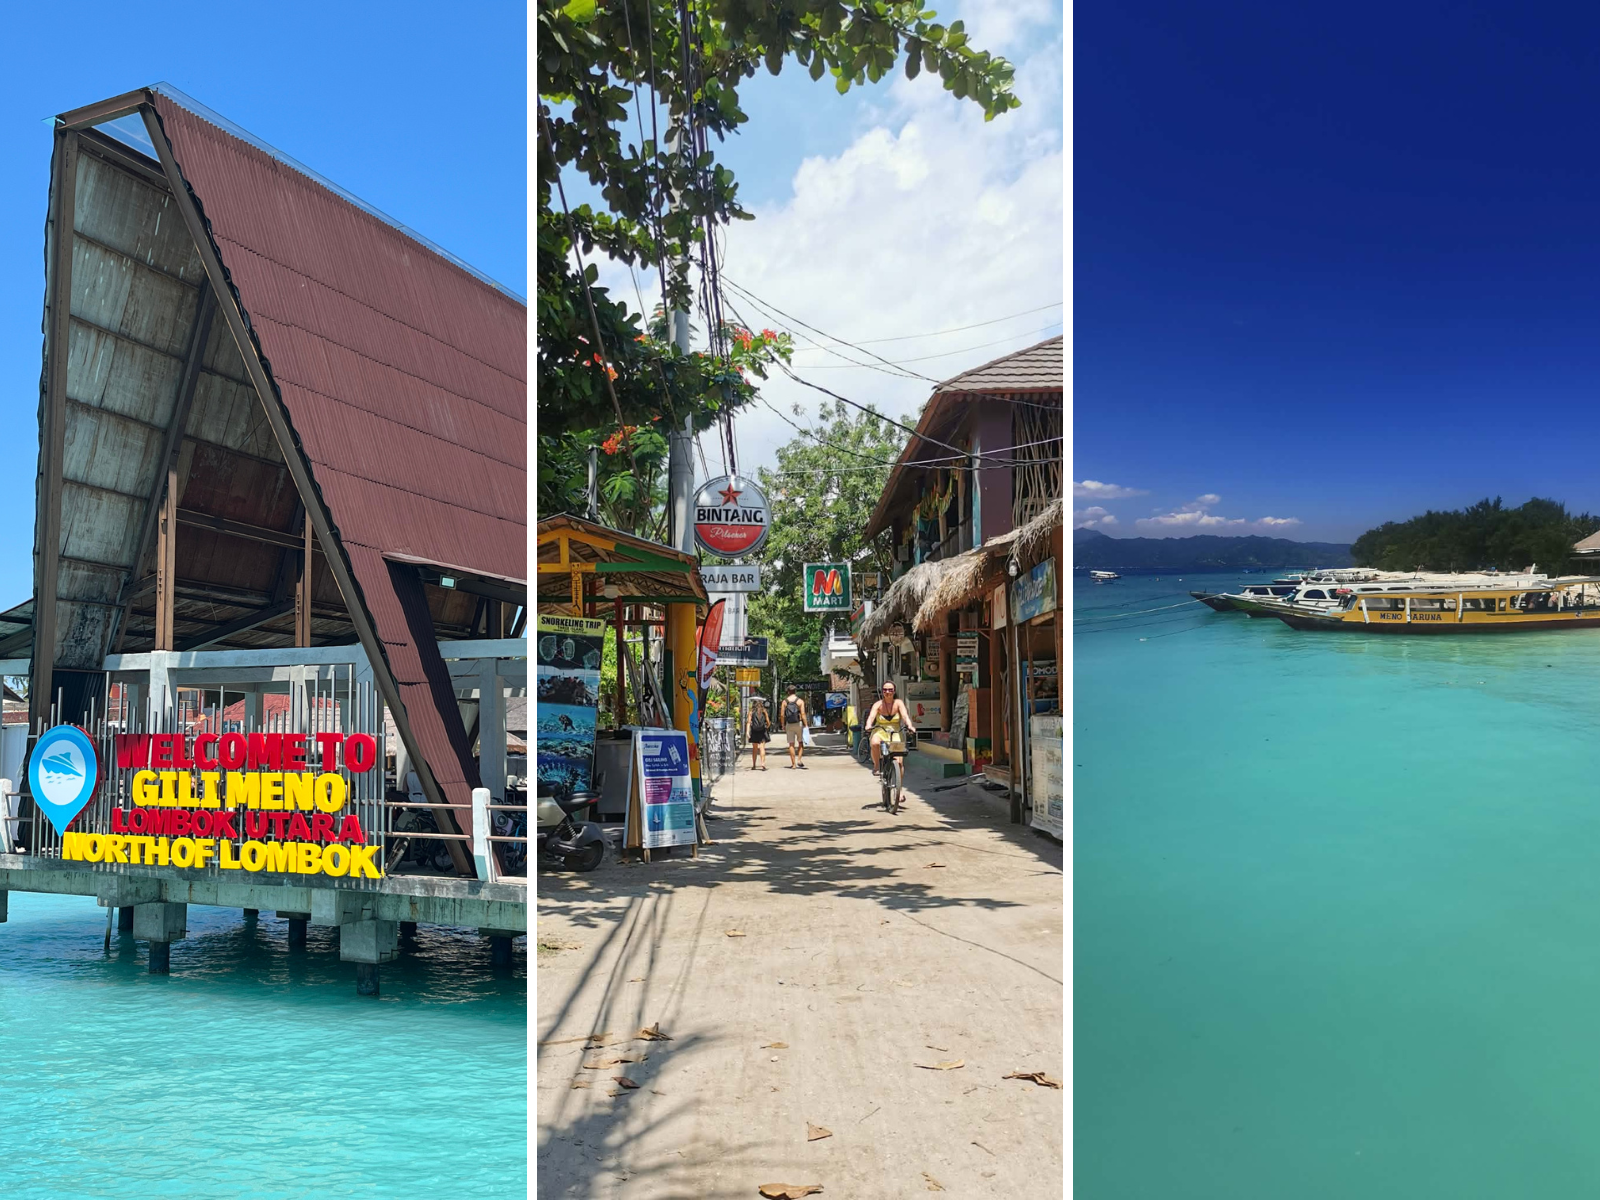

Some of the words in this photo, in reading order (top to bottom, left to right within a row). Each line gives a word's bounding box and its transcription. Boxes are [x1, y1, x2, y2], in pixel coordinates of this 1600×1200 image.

[697, 508, 763, 523] BINTANG
[702, 574, 728, 584] RAJA
[732, 574, 754, 584] BAR
[813, 597, 843, 606] MART
[541, 617, 584, 627] SNORKELING
[585, 621, 602, 629] TRIP
[115, 732, 306, 771] WELCOME
[316, 732, 376, 773] TO
[132, 769, 221, 809] GILI
[226, 771, 347, 813] MENO
[112, 807, 239, 839] LOMBOK
[245, 811, 366, 844] UTARA
[62, 831, 170, 866] NORTH
[171, 837, 216, 869] OF
[219, 838, 382, 880] LOMBOK
